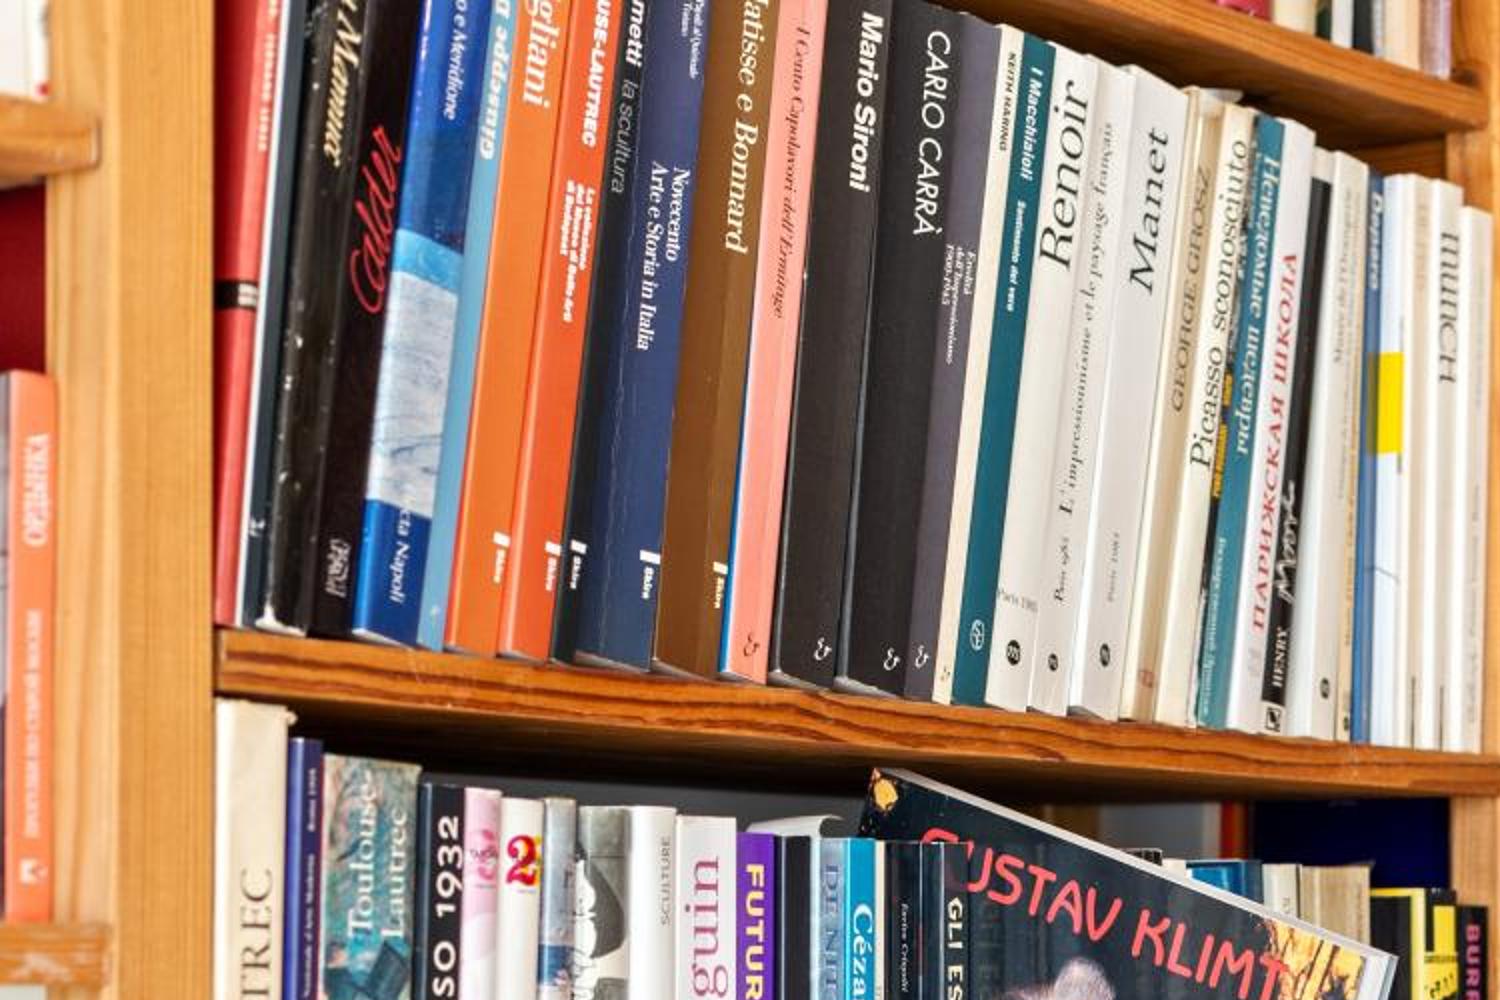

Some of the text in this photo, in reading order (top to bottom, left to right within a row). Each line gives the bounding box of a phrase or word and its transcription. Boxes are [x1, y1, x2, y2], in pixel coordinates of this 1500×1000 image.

[443, 12, 467, 120] e Meridione
[479, 25, 509, 159] Giuseppe
[621, 78, 638, 99] la
[736, 93, 752, 112] e
[791, 38, 807, 92] Cento
[848, 11, 883, 192] Mario Sironi
[998, 51, 1017, 151] KEITH HARING
[610, 102, 632, 193] scultura
[783, 95, 802, 193] Capolavori
[912, 30, 951, 234] CARLO CARRÀ
[1019, 66, 1044, 180] I Macchiaioli
[1039, 79, 1088, 268] Renoir
[1089, 122, 1112, 195] français
[349, 125, 401, 313] Calder
[665, 166, 690, 261] Novecento
[724, 119, 758, 253] Bonnard
[1129, 130, 1168, 293] Manet
[636, 161, 668, 350] Arte e Storia in Italia
[1079, 281, 1095, 297] le
[1089, 201, 1106, 278] paysage
[1172, 165, 1212, 412] GEORGE GROSZ
[1083, 301, 1095, 322] et
[1189, 346, 1223, 470] Picasso
[1213, 139, 1248, 332] sconosciuto
[1234, 154, 1283, 454] Неведомые шедевры
[1252, 254, 1297, 629] ПАРИЖСКАЯ ШКОЛА
[389, 540, 409, 602] Napoli
[1271, 626, 1287, 687] HENRY
[380, 807, 407, 937] Lautrec
[435, 814, 467, 920] 1932
[659, 834, 672, 926] SCULTURE
[824, 863, 838, 912] DE
[947, 897, 963, 949] GLI
